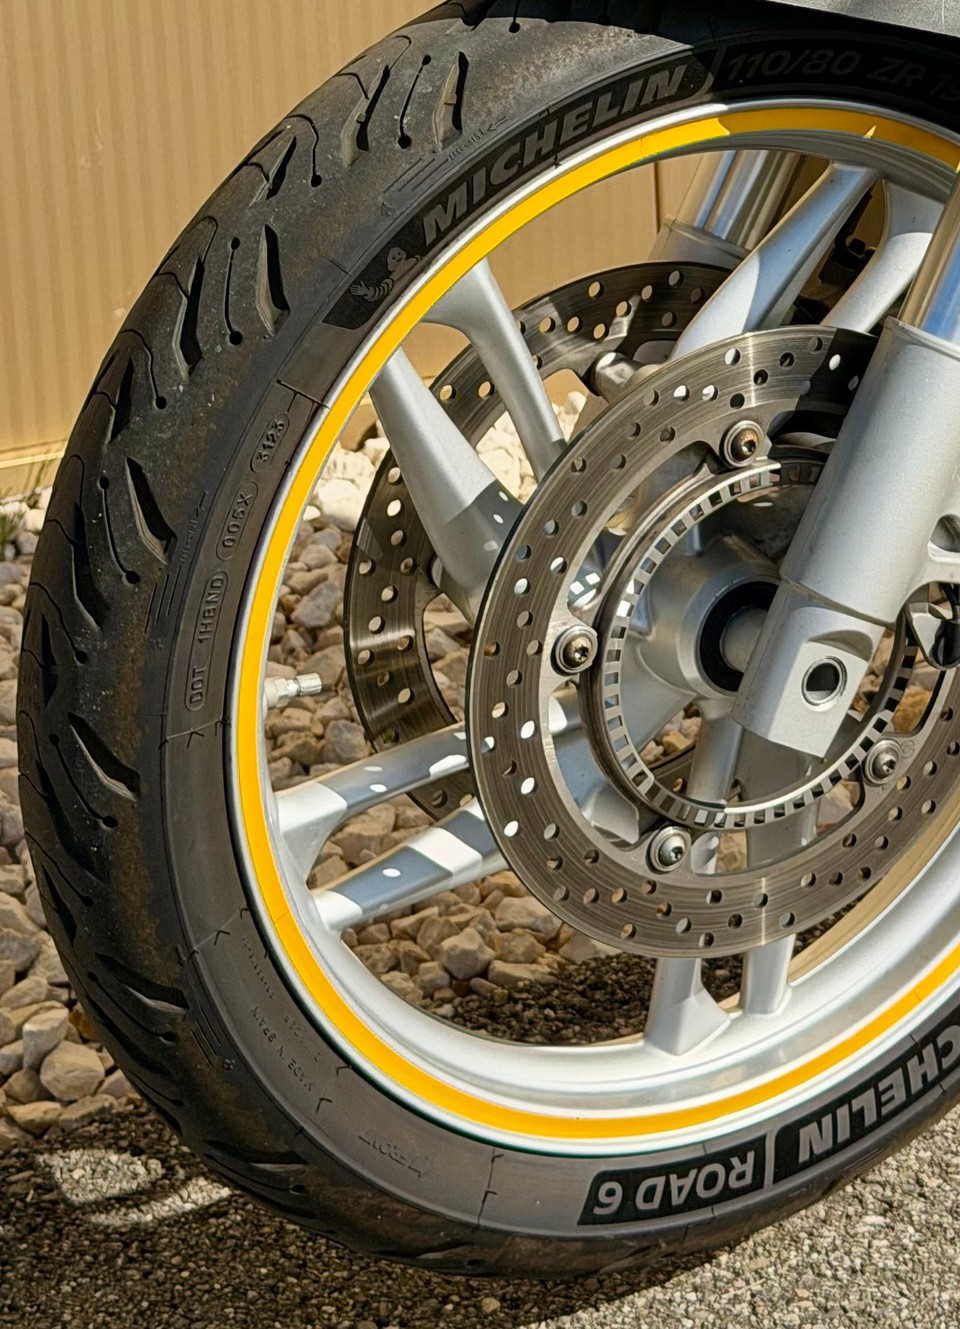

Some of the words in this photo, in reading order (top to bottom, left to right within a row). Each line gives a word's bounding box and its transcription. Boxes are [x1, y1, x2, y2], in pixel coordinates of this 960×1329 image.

[726, 49, 862, 81] 110/80
[866, 56, 927, 87] ZR
[422, 65, 687, 247] MICHELIN
[189, 666, 207, 708] DOT
[592, 1181, 623, 1216] 6
[635, 1150, 755, 1211] ROAD
